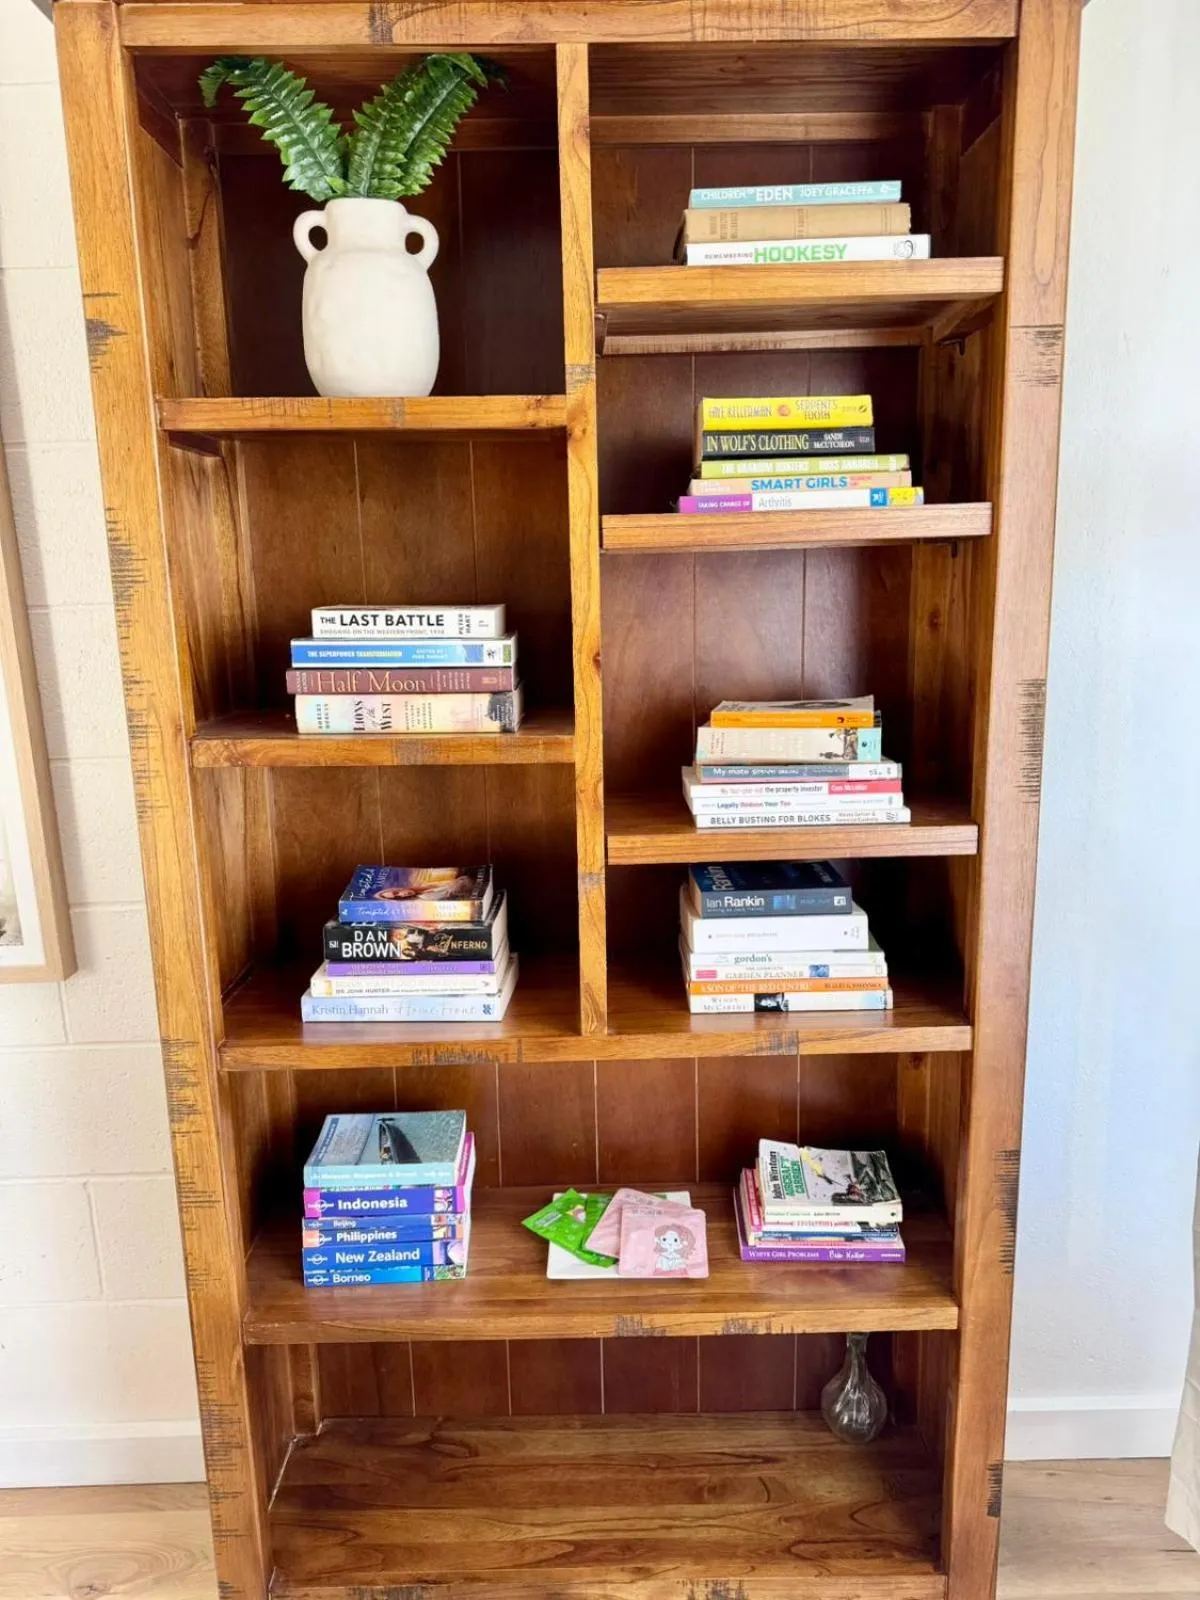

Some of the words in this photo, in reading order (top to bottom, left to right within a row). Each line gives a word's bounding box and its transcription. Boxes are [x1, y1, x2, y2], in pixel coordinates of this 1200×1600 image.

[756, 186, 793, 202] EDEN
[753, 243, 848, 263] HOOKESY
[706, 436, 718, 452] IN
[719, 434, 757, 451] WOLF'S
[758, 433, 809, 451] CLOTHING
[751, 478, 802, 491] SMART
[806, 475, 848, 489] GIRLS
[757, 496, 792, 508] Arthritis
[320, 616, 337, 624] THE
[340, 614, 379, 626] LAST
[385, 614, 444, 626] BATTLE
[316, 671, 362, 693] Half
[367, 671, 426, 692] Moon
[713, 768, 726, 777] My
[710, 816, 737, 825] BELLY
[738, 815, 776, 824] BUSTING
[778, 814, 795, 823] FOR
[797, 813, 831, 823] BLOKES
[706, 898, 722, 909] Ian
[724, 895, 765, 908] Rankin
[355, 931, 388, 942] DAN
[341, 943, 401, 958] BROWN
[734, 953, 773, 965] gordon's
[763, 970, 804, 978] PLANNER
[311, 1003, 347, 1016] Kristin
[348, 1002, 389, 1015] Hannah
[337, 1195, 409, 1211] Indonesia
[333, 1219, 357, 1229] Beijing
[336, 1230, 398, 1244] Philippines
[335, 1251, 366, 1265] New
[367, 1248, 421, 1263] Zealand
[748, 1250, 771, 1258] WHITE
[771, 1250, 786, 1258] GIRL
[332, 1272, 371, 1284] Borneo
